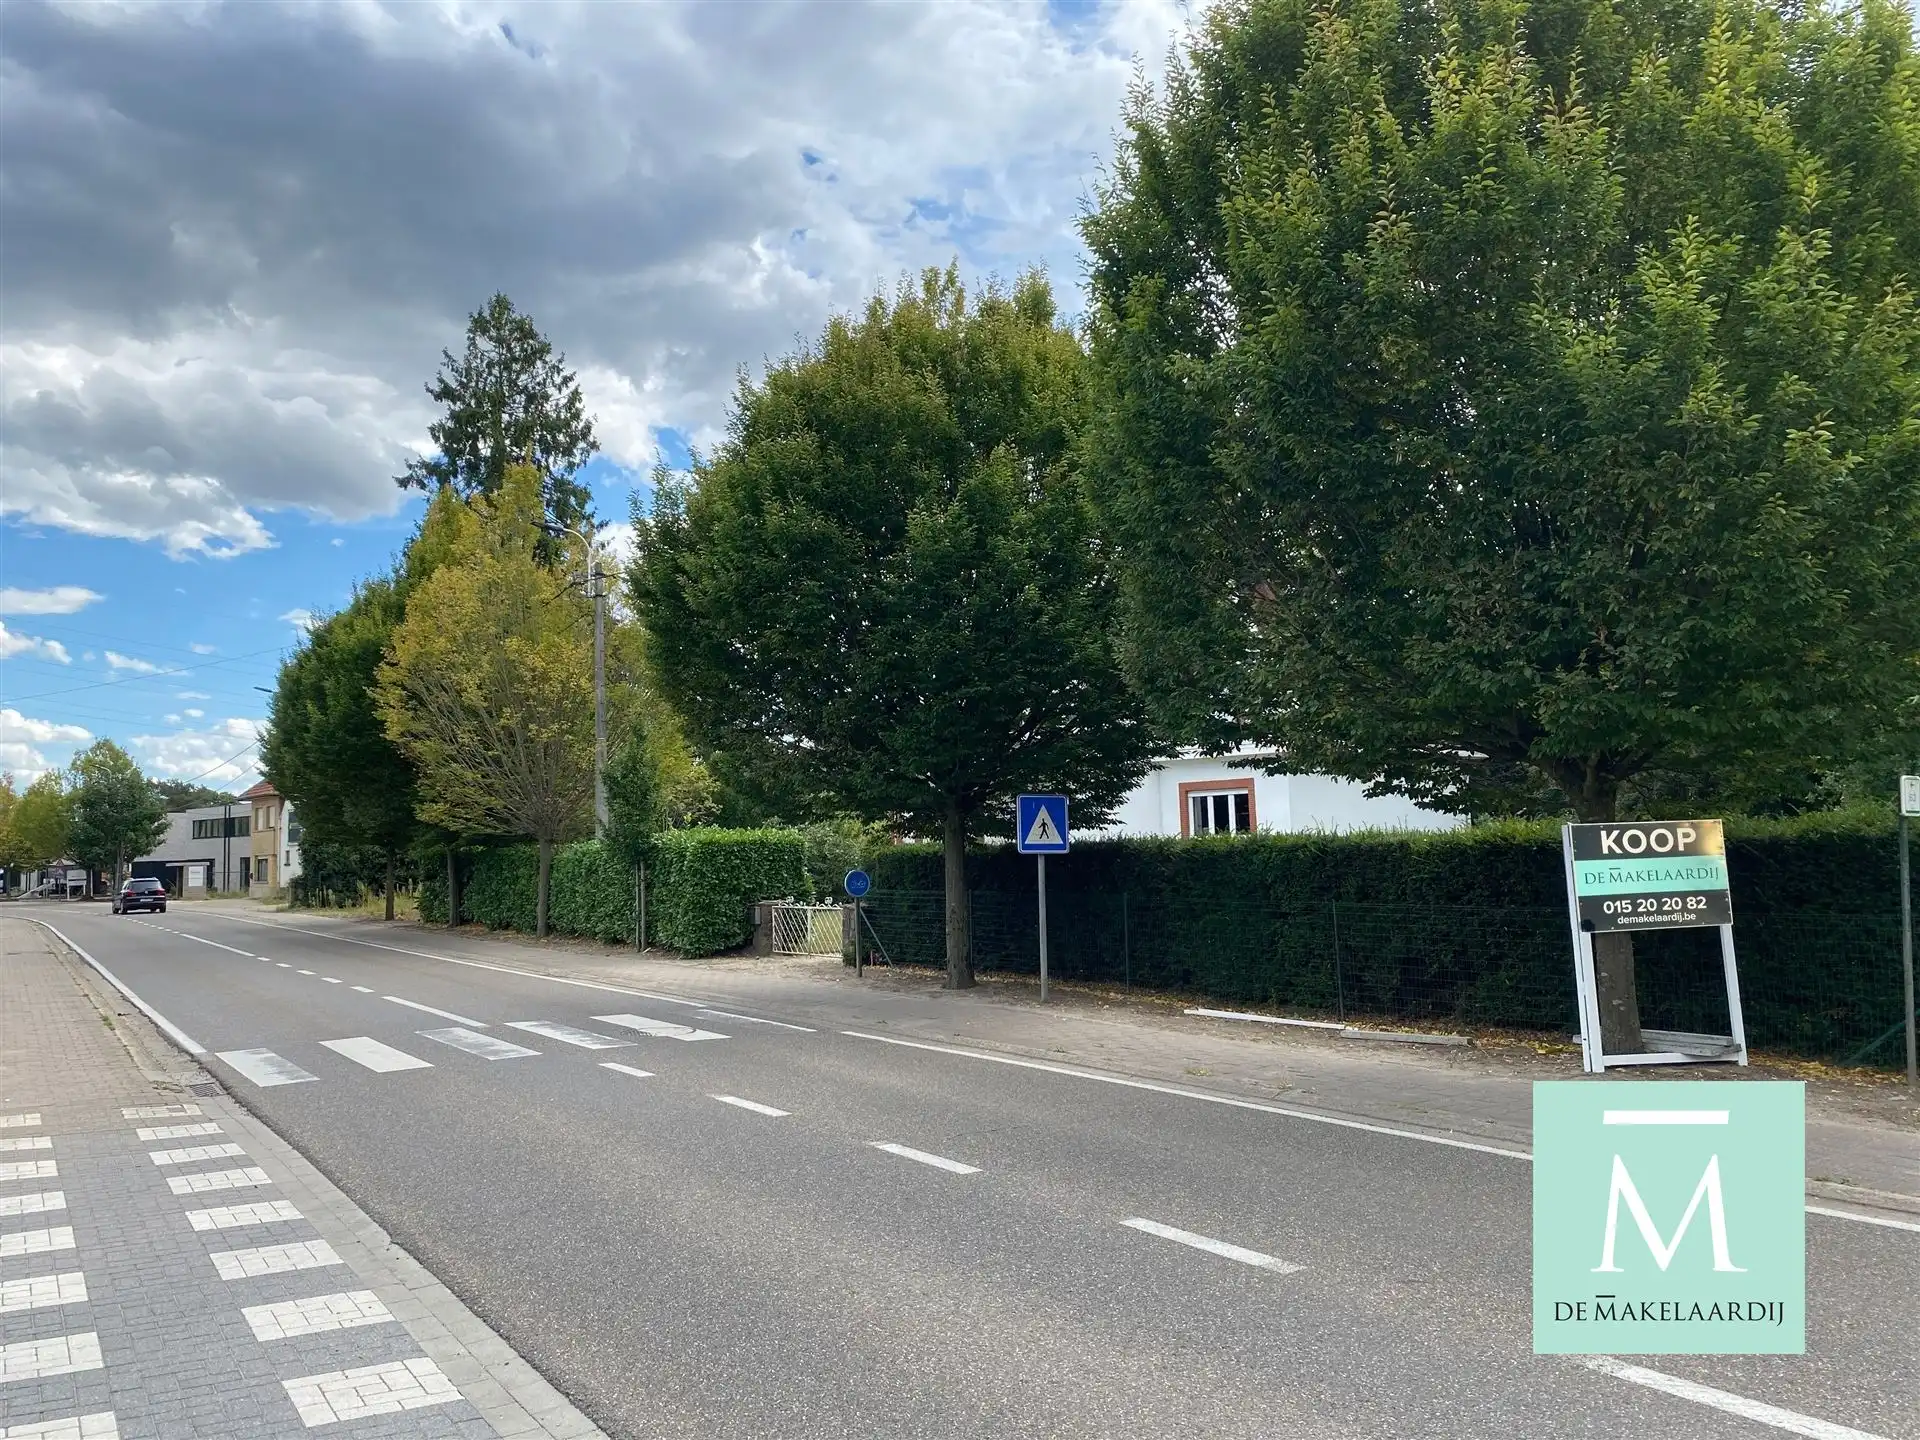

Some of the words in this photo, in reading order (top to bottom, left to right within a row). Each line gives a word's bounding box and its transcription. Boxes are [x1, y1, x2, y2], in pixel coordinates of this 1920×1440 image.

[1600, 828, 1697, 854] KOOP
[1584, 871, 1605, 885] DE
[1609, 867, 1720, 884] MAKELAARDIJ
[1603, 900, 1633, 914] 015
[1637, 899, 1657, 912] 20
[1662, 897, 1682, 911] 20
[1686, 896, 1707, 910] 82
[1617, 912, 1697, 925] demakelaardij.be
